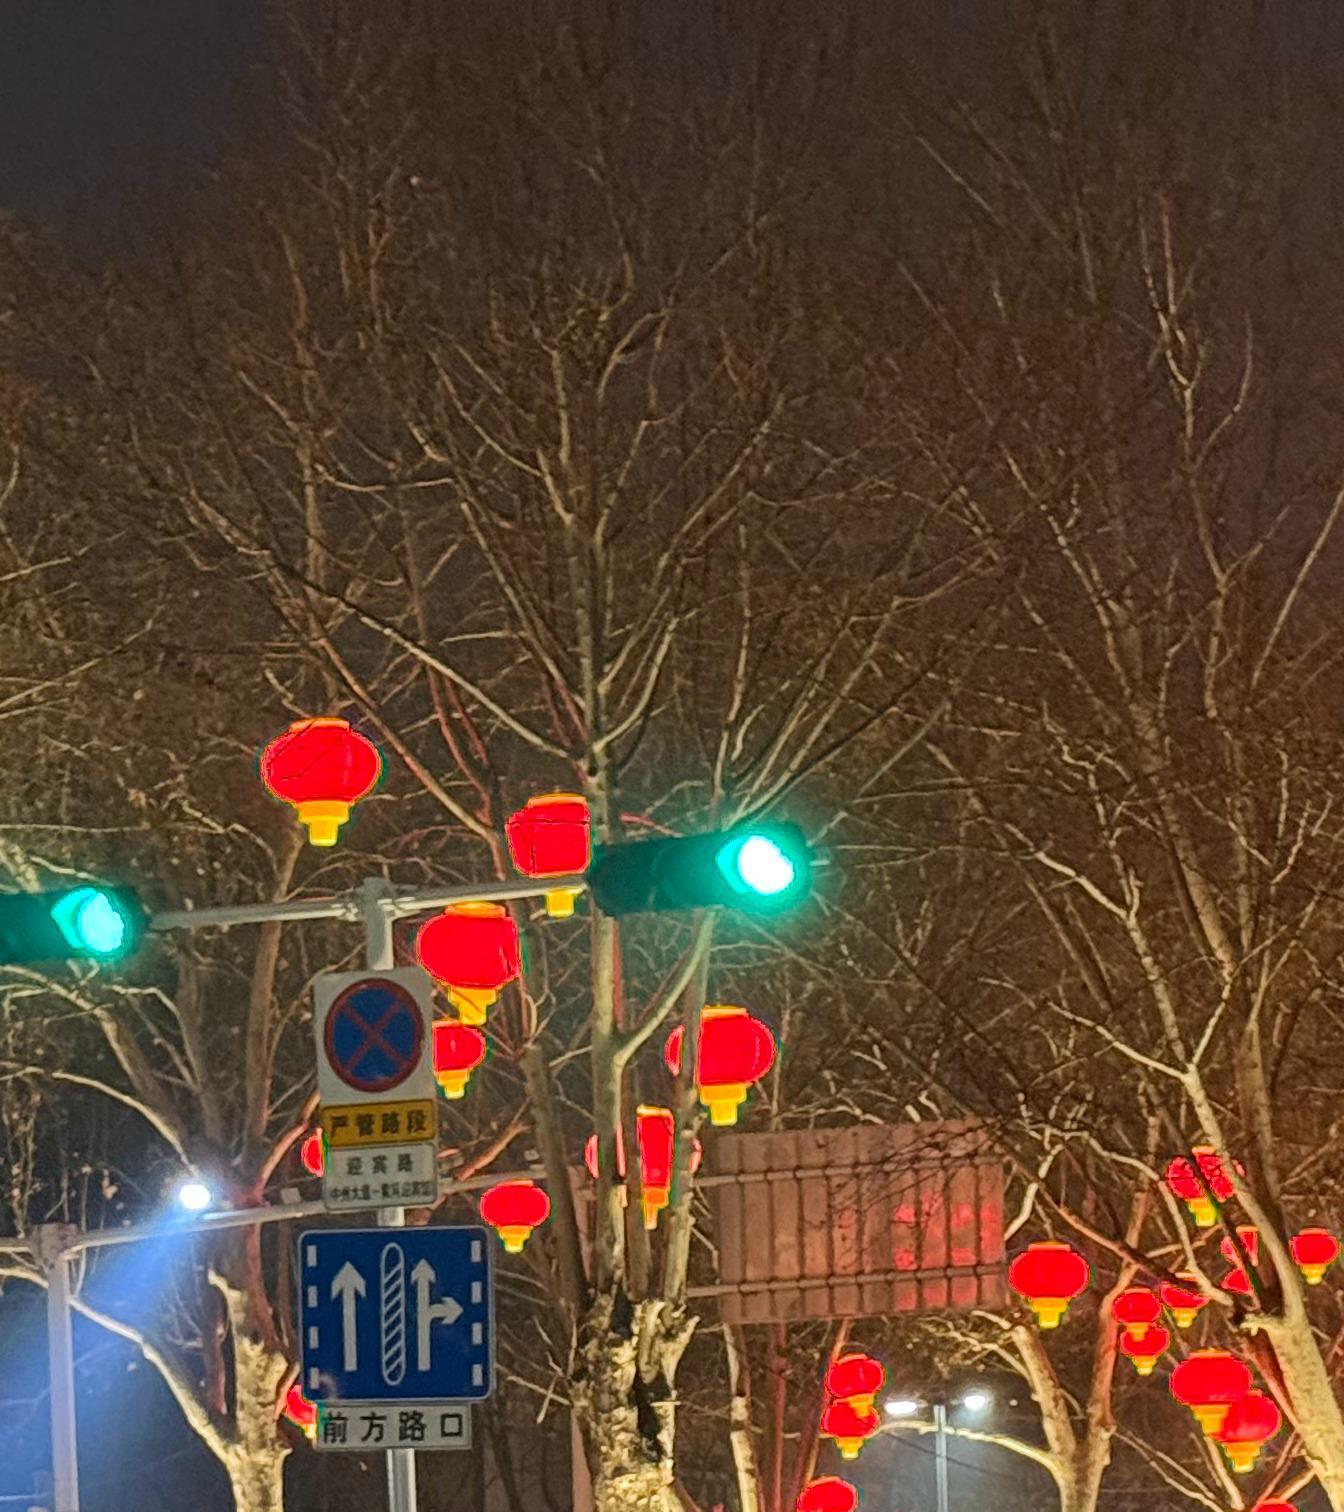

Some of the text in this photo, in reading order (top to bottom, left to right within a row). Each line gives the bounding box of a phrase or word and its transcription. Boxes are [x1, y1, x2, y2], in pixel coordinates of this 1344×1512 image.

[331, 1109, 427, 1137] 严管路段
[347, 1153, 413, 1175] 迎宾路
[323, 1410, 463, 1443] 前方路口
